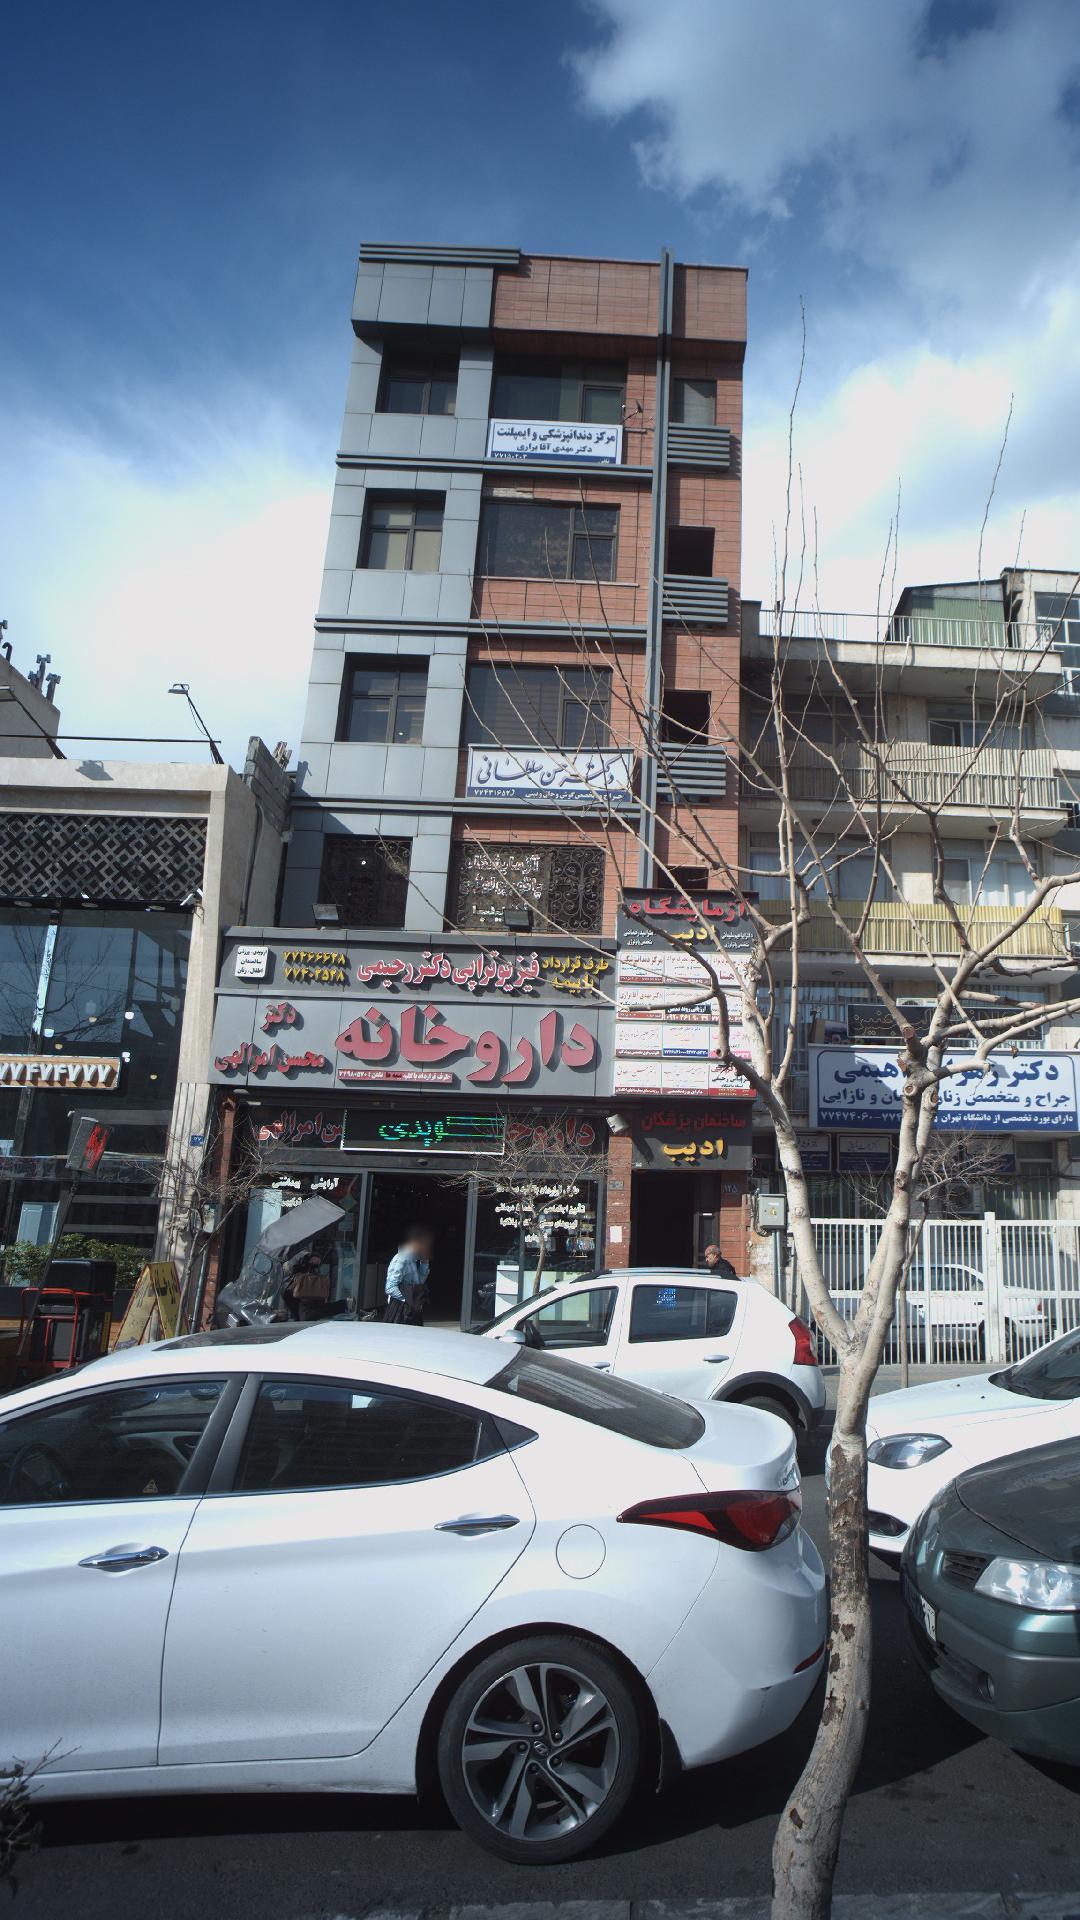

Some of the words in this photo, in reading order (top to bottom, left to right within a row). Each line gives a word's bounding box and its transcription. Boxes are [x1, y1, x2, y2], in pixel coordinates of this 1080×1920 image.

[594, 431, 616, 444] مرکز
[552, 444, 574, 453] مهدی
[575, 445, 593, 454] دکتر
[413, 951, 451, 984] دکتر
[451, 949, 540, 993] فیزیوتراپی
[542, 955, 582, 974] قرارداد
[582, 957, 609, 975] طرف
[356, 957, 414, 989] رحیمی
[259, 1001, 297, 1031] دکتر
[335, 1003, 597, 1083] داروخانه
[278, 1050, 326, 1074] محسن
[1006, 1060, 1059, 1088] دکتر
[822, 1087, 865, 1105] نازایی
[869, 1093, 877, 1105] و
[965, 1091, 1020, 1107] متخصص
[1024, 1095, 1031, 1108] و
[1035, 1091, 1071, 1108] جراح
[940, 1114, 962, 1125] تهران
[962, 1112, 992, 1123] دانشگاه
[993, 1113, 1001, 1125] از
[1001, 1113, 1033, 1124] تخصصی
[1032, 1115, 1051, 1126] بورد
[1050, 1113, 1074, 1125] دارای
[663, 1137, 724, 1163] ادیب
[271, 1176, 302, 1190] بهداشتی
[310, 1177, 340, 1190] آرایشی
